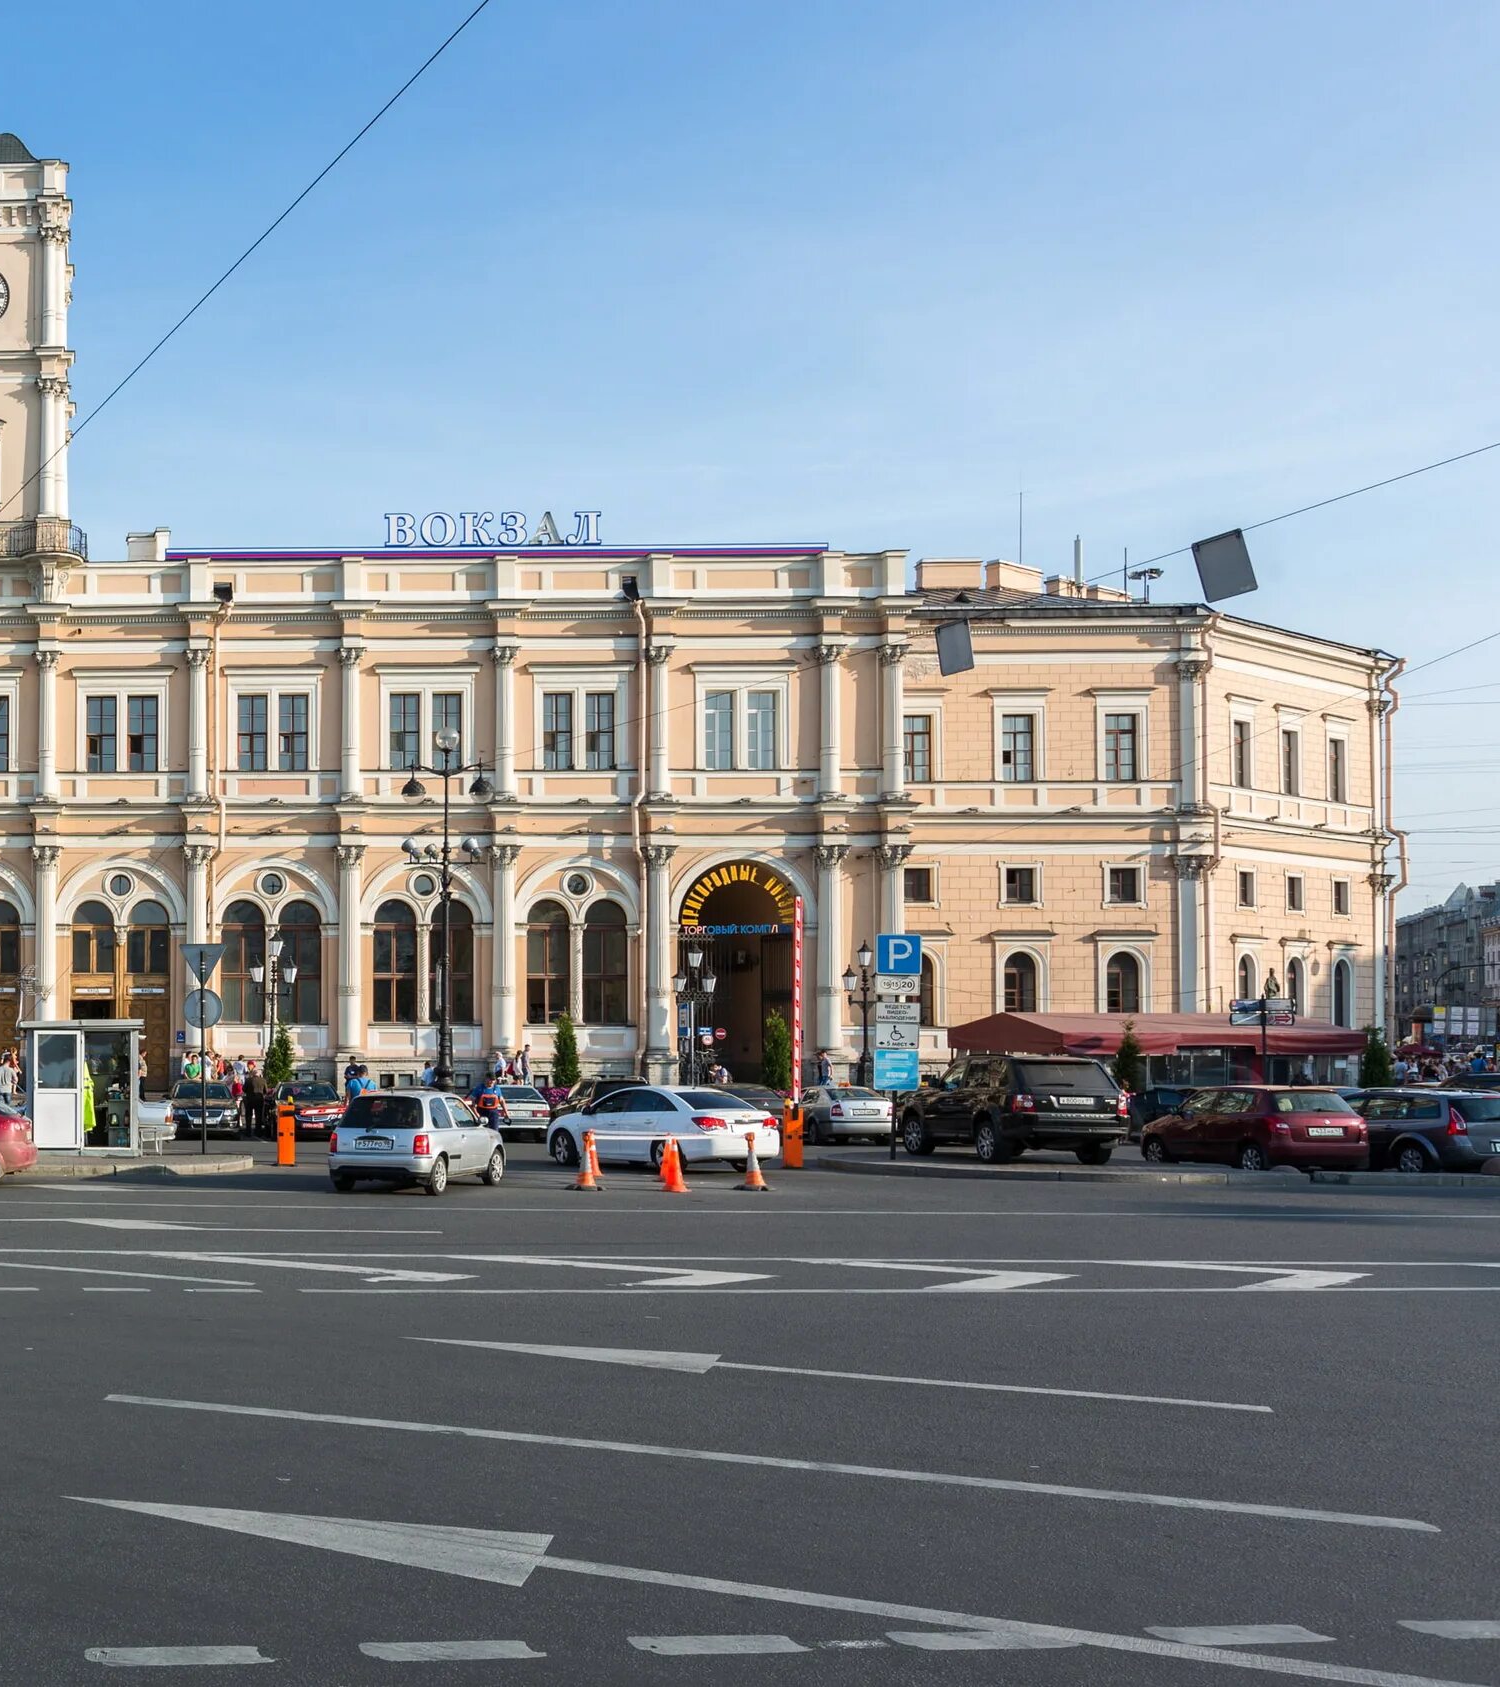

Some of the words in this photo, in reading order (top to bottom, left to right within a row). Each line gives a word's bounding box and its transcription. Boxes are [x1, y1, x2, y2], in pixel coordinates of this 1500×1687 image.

[384, 511, 601, 546] ВОКЗАЛ
[681, 864, 759, 926] ПРИГОРОДНЫЕ
[684, 924, 738, 935] ТОРГОВЫЙ
[888, 938, 913, 970] P
